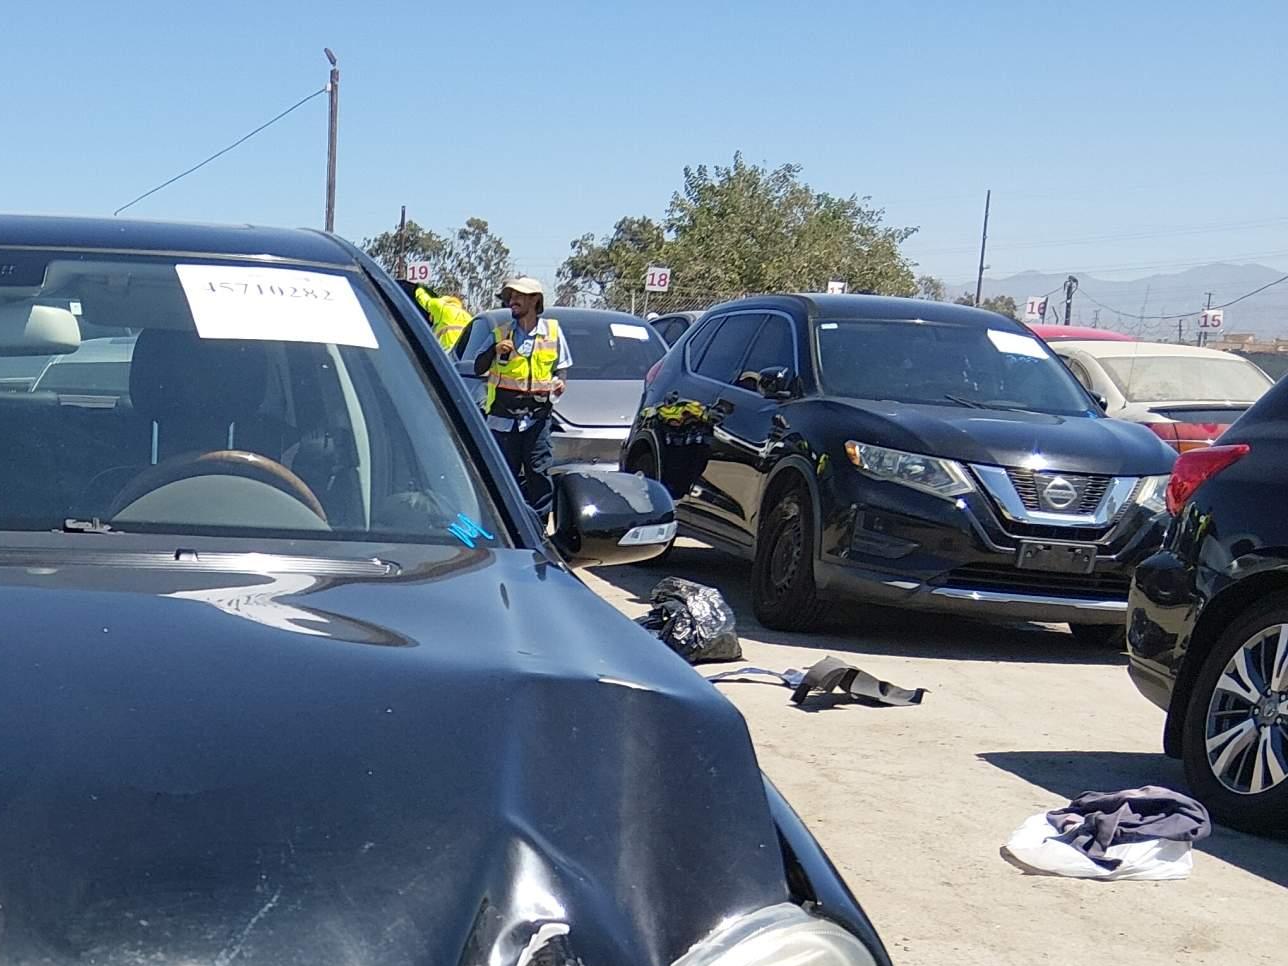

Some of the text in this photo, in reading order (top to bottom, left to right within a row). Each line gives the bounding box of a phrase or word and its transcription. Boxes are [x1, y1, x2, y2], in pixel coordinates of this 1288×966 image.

[408, 265, 428, 281] 19
[647, 271, 668, 287] 18
[1199, 313, 1221, 328] 15
